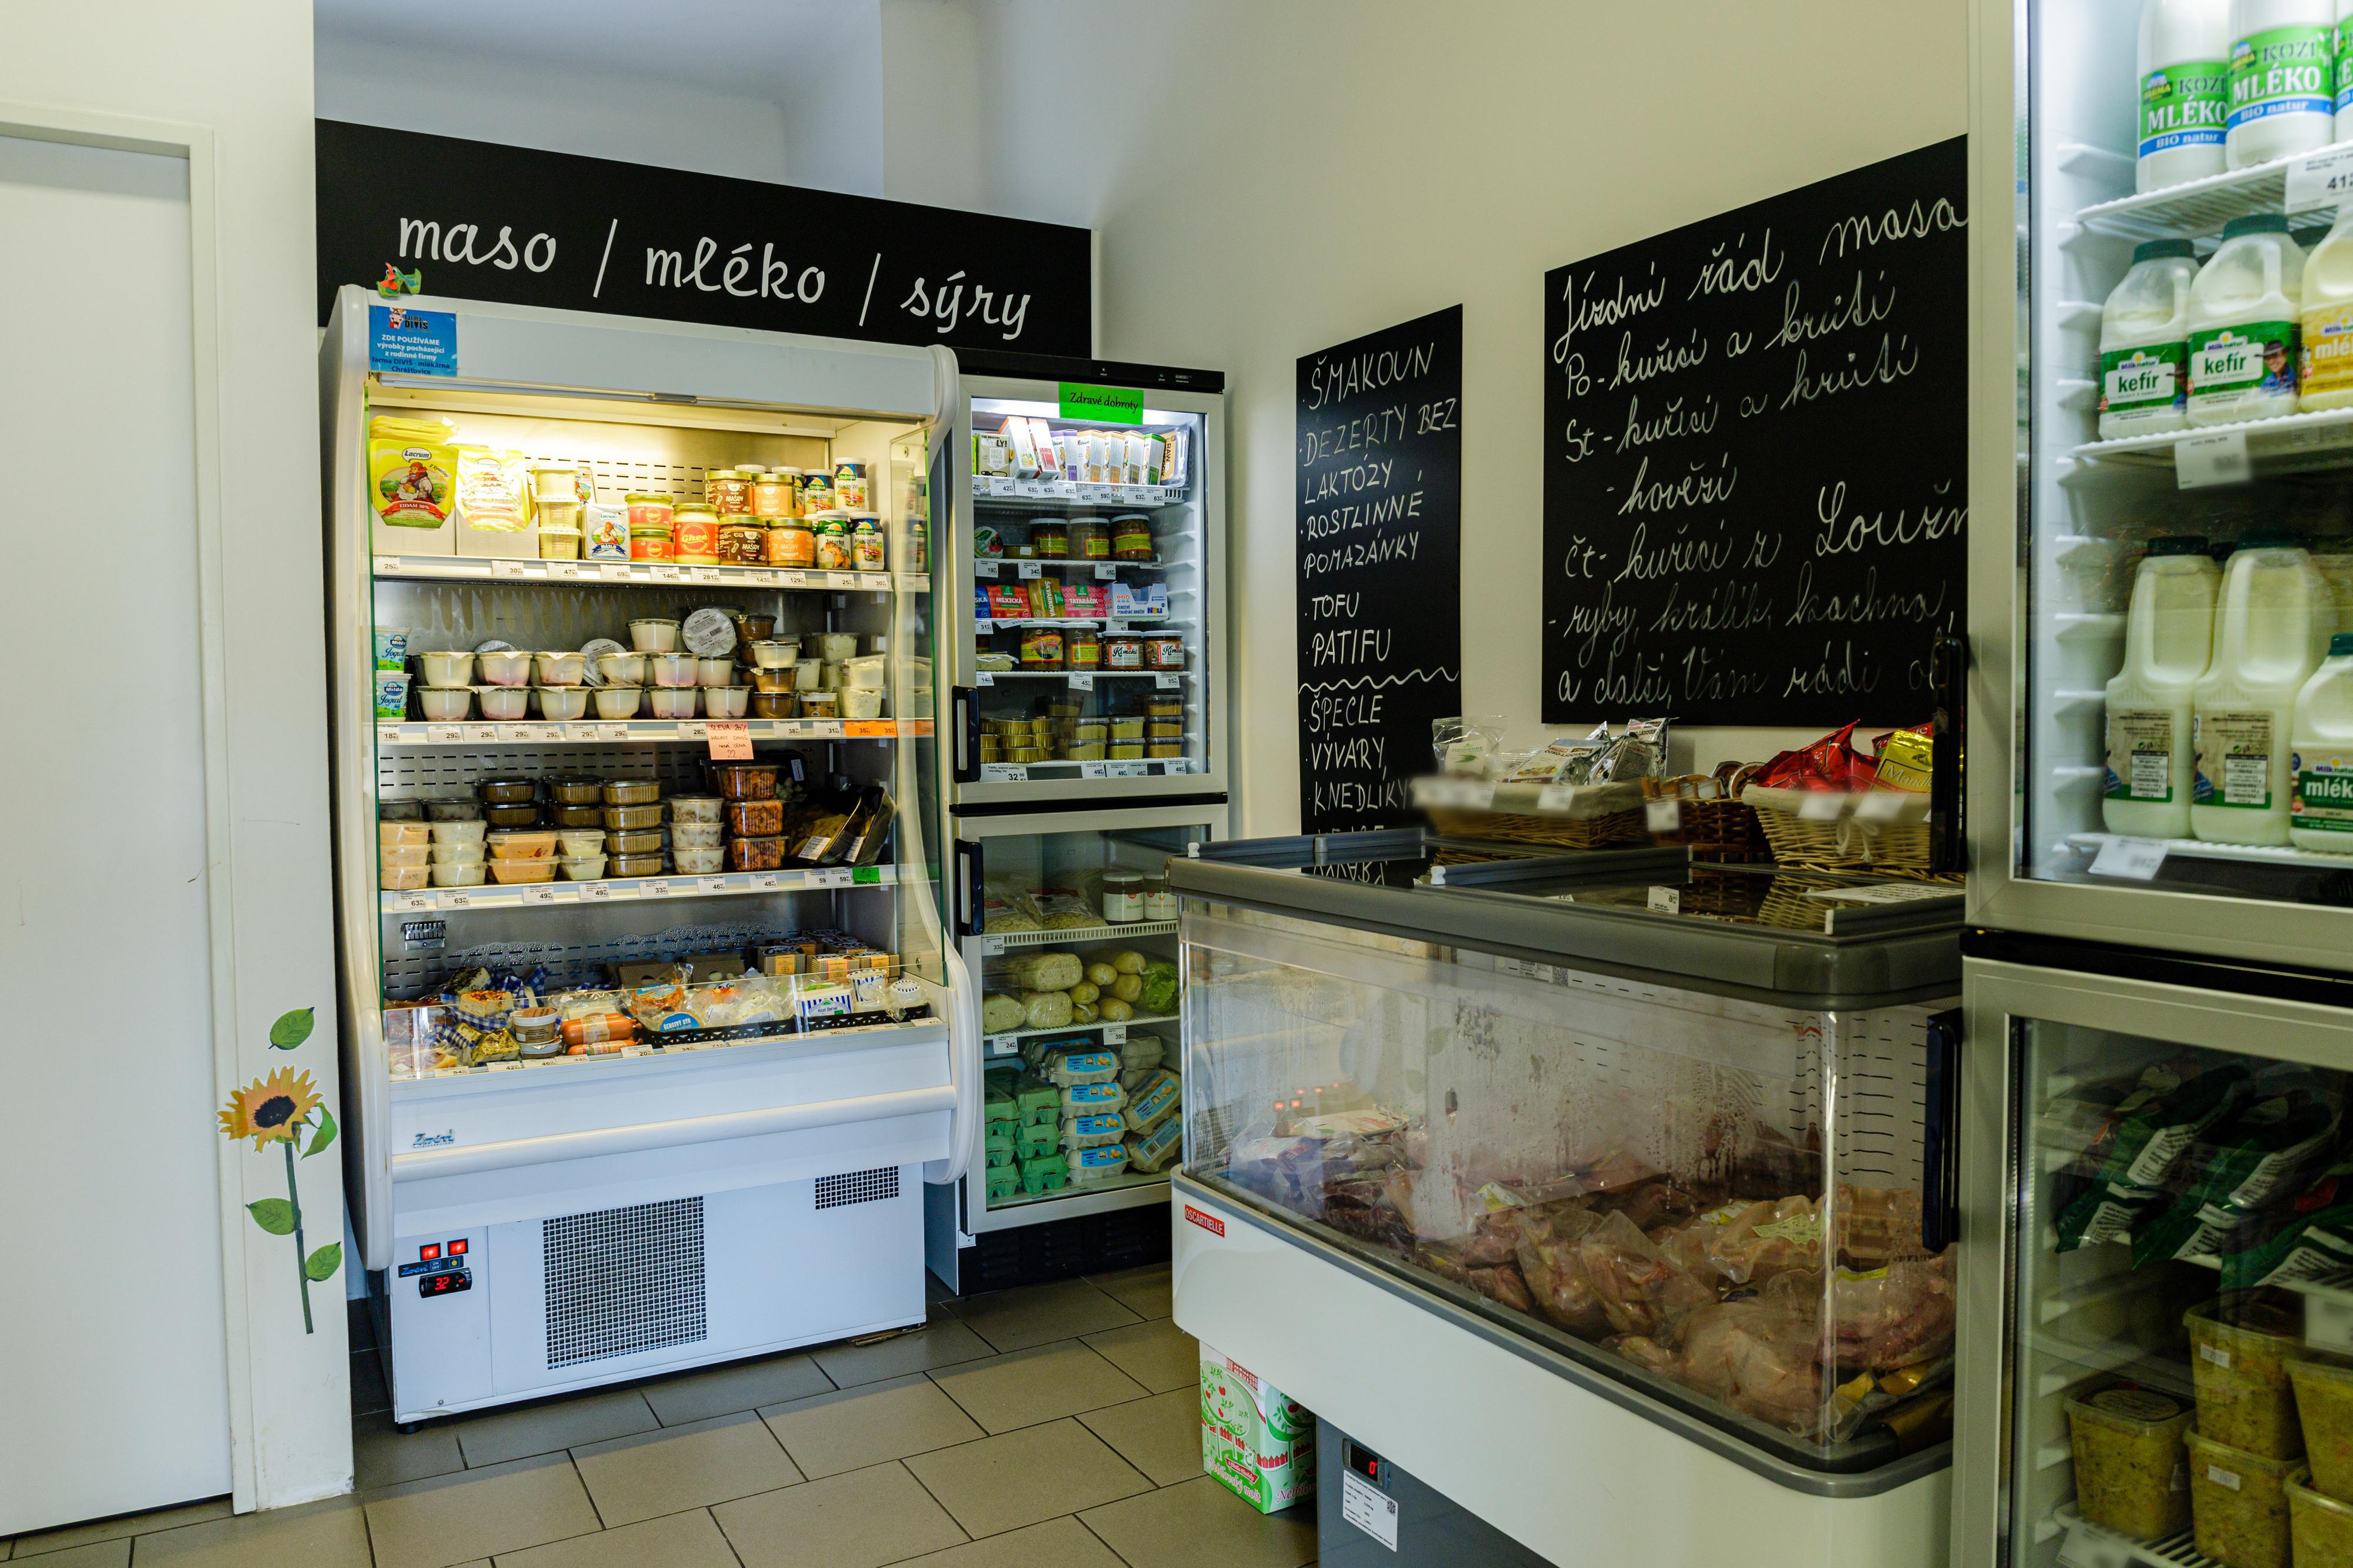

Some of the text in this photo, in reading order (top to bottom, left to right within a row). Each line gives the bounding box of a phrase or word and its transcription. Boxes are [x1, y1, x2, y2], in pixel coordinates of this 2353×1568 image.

[2263, 38, 2317, 62] KOZÍ
[2179, 74, 2226, 94] KOZÍ
[2233, 62, 2321, 105] MLÉKO
[2147, 93, 2228, 134] MLÉKO
[2241, 101, 2309, 122] BIO natur
[2157, 131, 2219, 148] BIO natur
[397, 215, 557, 275] maso
[646, 236, 825, 303] mléko
[901, 271, 1031, 339] sýry
[1554, 198, 1968, 363] Jízdní řád masa
[405, 321, 428, 329] DIVIŠ
[377, 342, 445, 354] výrobky pocházející
[397, 336, 440, 346] POUŽÍVÁME
[418, 352, 437, 361] firmy
[418, 360, 450, 369] mlékárna
[1609, 328, 1707, 391] kuřecí
[1726, 331, 1752, 358] a
[2204, 351, 2247, 375] kefír
[391, 366, 431, 375] Chrášťovice
[1308, 342, 1434, 410] ŠMAKOUN
[2118, 371, 2159, 393] kefír
[1069, 392, 1138, 413] Zdravé dobroty
[1304, 398, 1457, 466] DEZERTY BEZ
[1617, 394, 1719, 455] kuřecí
[1740, 393, 1768, 418] a
[1305, 453, 1392, 505] LAKTÓZY
[1307, 470, 1424, 541] ROSTLINNÉ
[681, 533, 708, 543] Ghee
[1304, 528, 1419, 579] POMAZÁNKY
[1614, 519, 1732, 583] kuřecí
[1045, 581, 1057, 617] ŠKVARKOVÁ
[1312, 592, 1359, 621] TOFU
[382, 648, 405, 659] Jogurt
[1112, 646, 1138, 657] Kimchi
[1162, 645, 1184, 656] Kimchi
[1312, 629, 1391, 666] PATIFU
[1559, 670, 1581, 702] a
[378, 695, 403, 706] Jogurt
[1308, 691, 1383, 733] ŠPECLE
[2305, 777, 2353, 799] mlék
[1185, 1206, 1224, 1235] OSCARTIELLE
[1244, 1484, 1261, 1503] mošt
